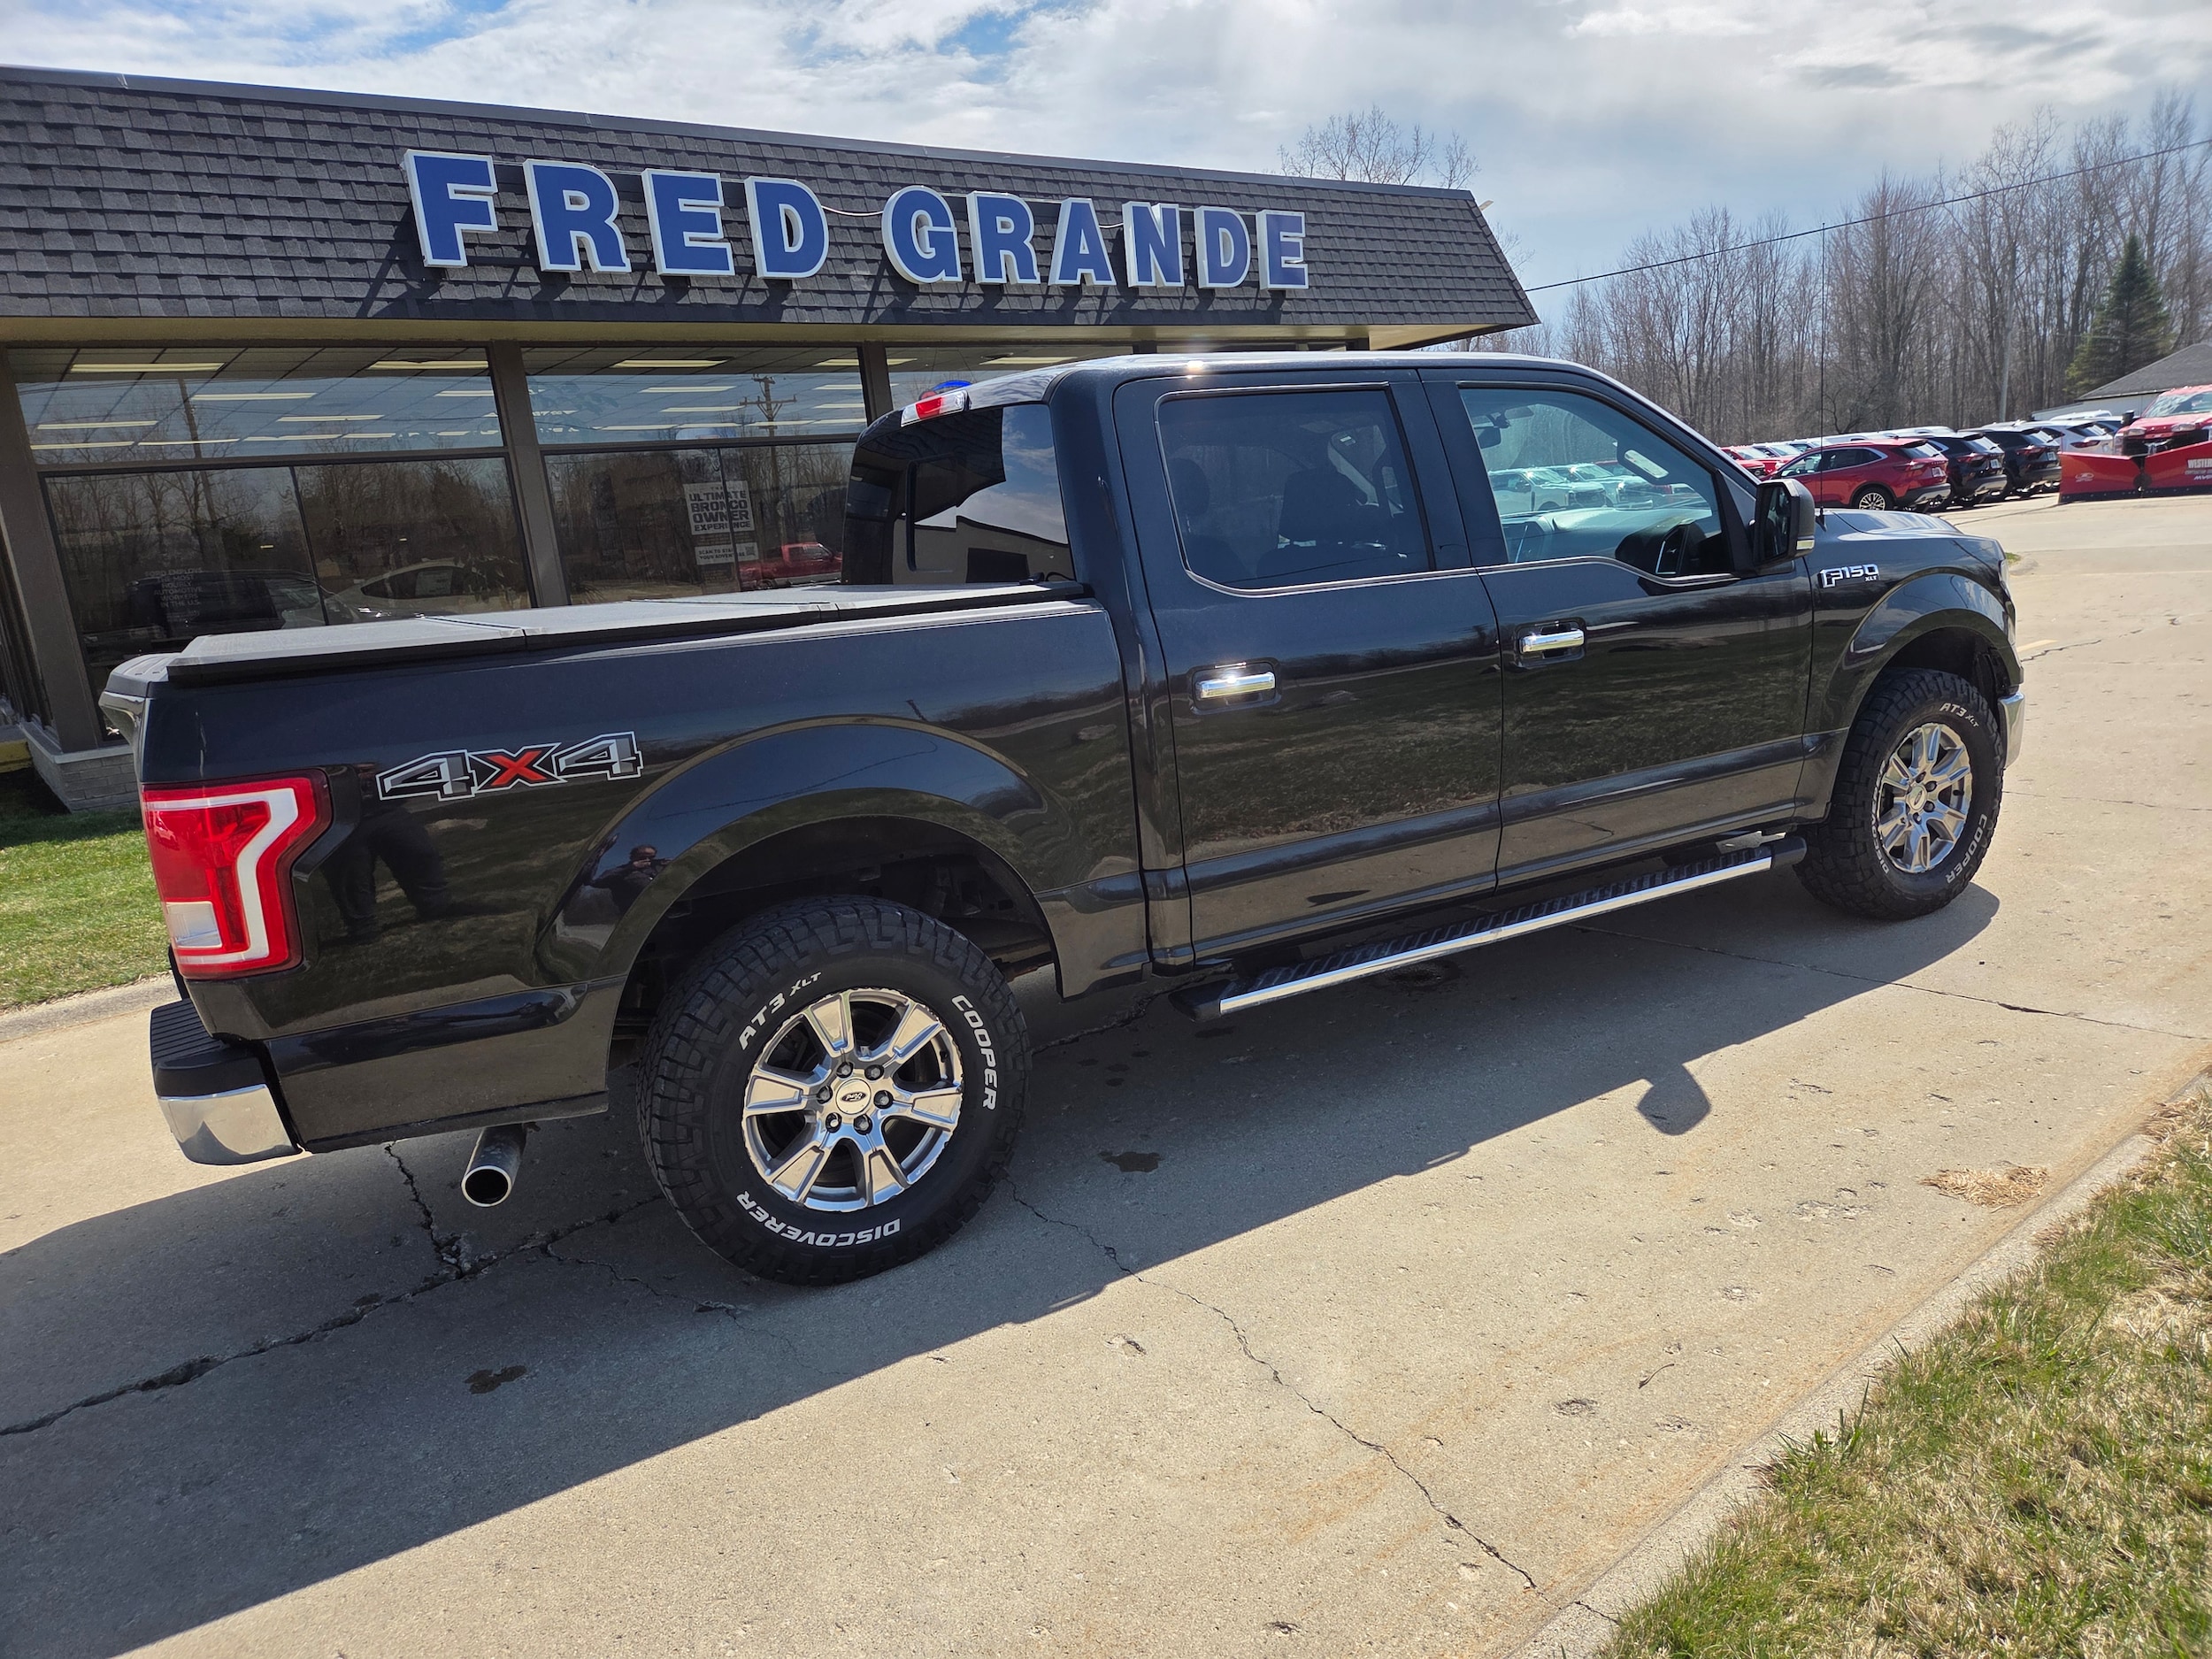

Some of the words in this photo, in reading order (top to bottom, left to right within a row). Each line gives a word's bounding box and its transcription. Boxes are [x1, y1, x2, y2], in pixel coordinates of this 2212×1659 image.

[404, 149, 829, 280] FRED
[882, 185, 1310, 290] GRANDE
[688, 490, 747, 502] ULTIMATE
[690, 499, 748, 512] BRONCO
[693, 510, 750, 523] OWNER
[694, 520, 751, 532] EXPERINCE
[154, 587, 204, 595] AUTOMOTIVE
[161, 580, 193, 589] HOURLY
[1939, 703, 1967, 718] AT3
[1966, 713, 1979, 728] XLT
[1945, 813, 1988, 885] COOPER
[738, 992, 786, 1050] AT3
[789, 972, 821, 996] XLT
[951, 995, 998, 1110] COOPER
[735, 1190, 902, 1248] DISCOVERER
